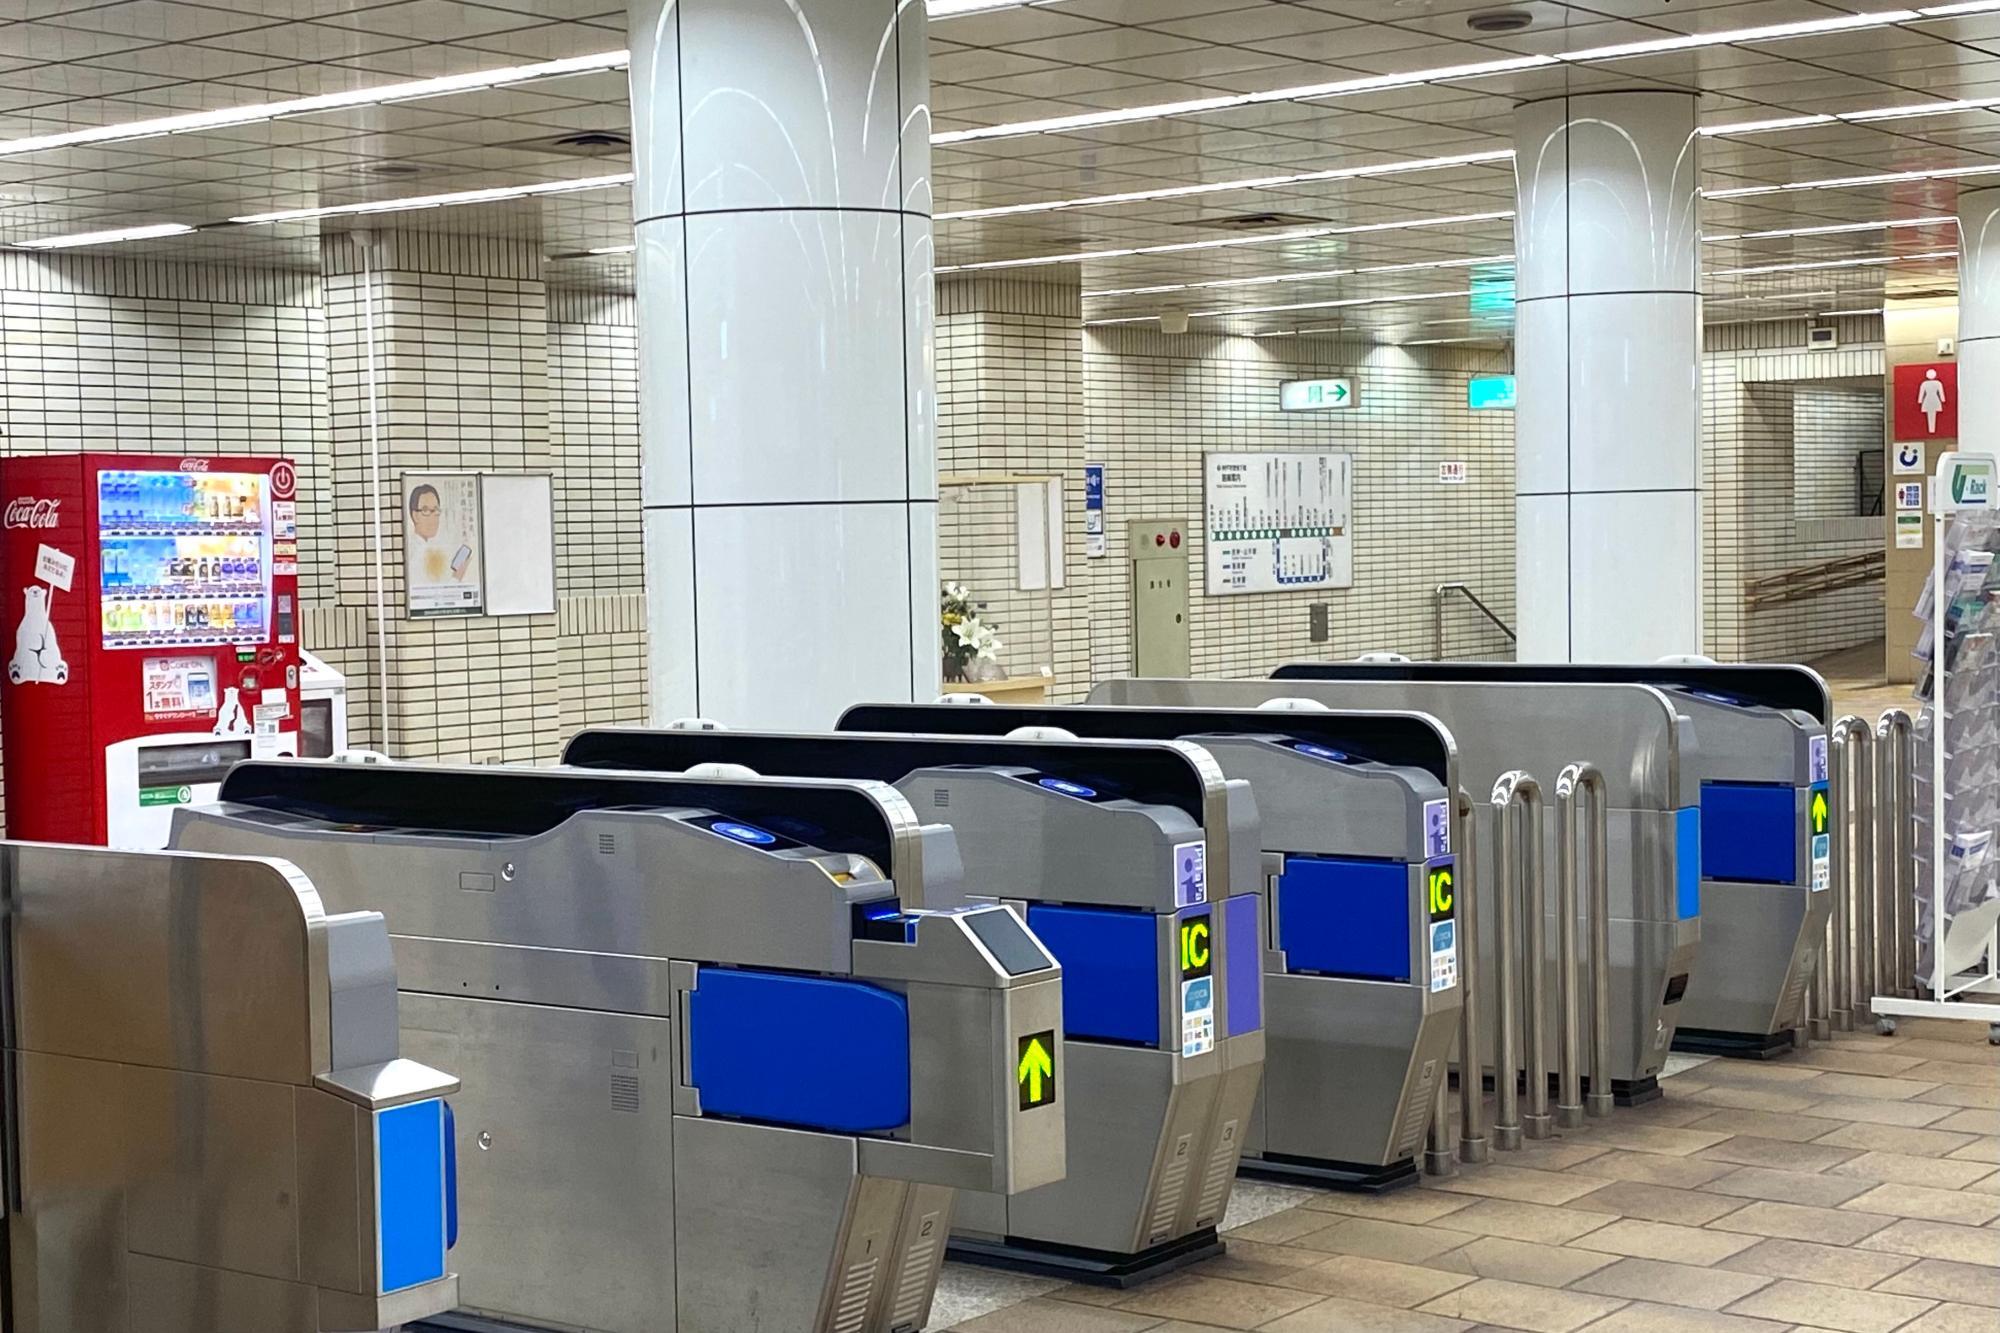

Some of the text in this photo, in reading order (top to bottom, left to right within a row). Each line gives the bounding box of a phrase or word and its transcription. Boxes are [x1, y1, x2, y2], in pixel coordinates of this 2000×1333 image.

[4, 498, 61, 529] Coca-Cola
[1429, 872, 1452, 914] IC
[1181, 923, 1209, 971] IC
[1177, 1127, 1233, 1156] 2 3
[866, 1220, 933, 1255] 1 2
